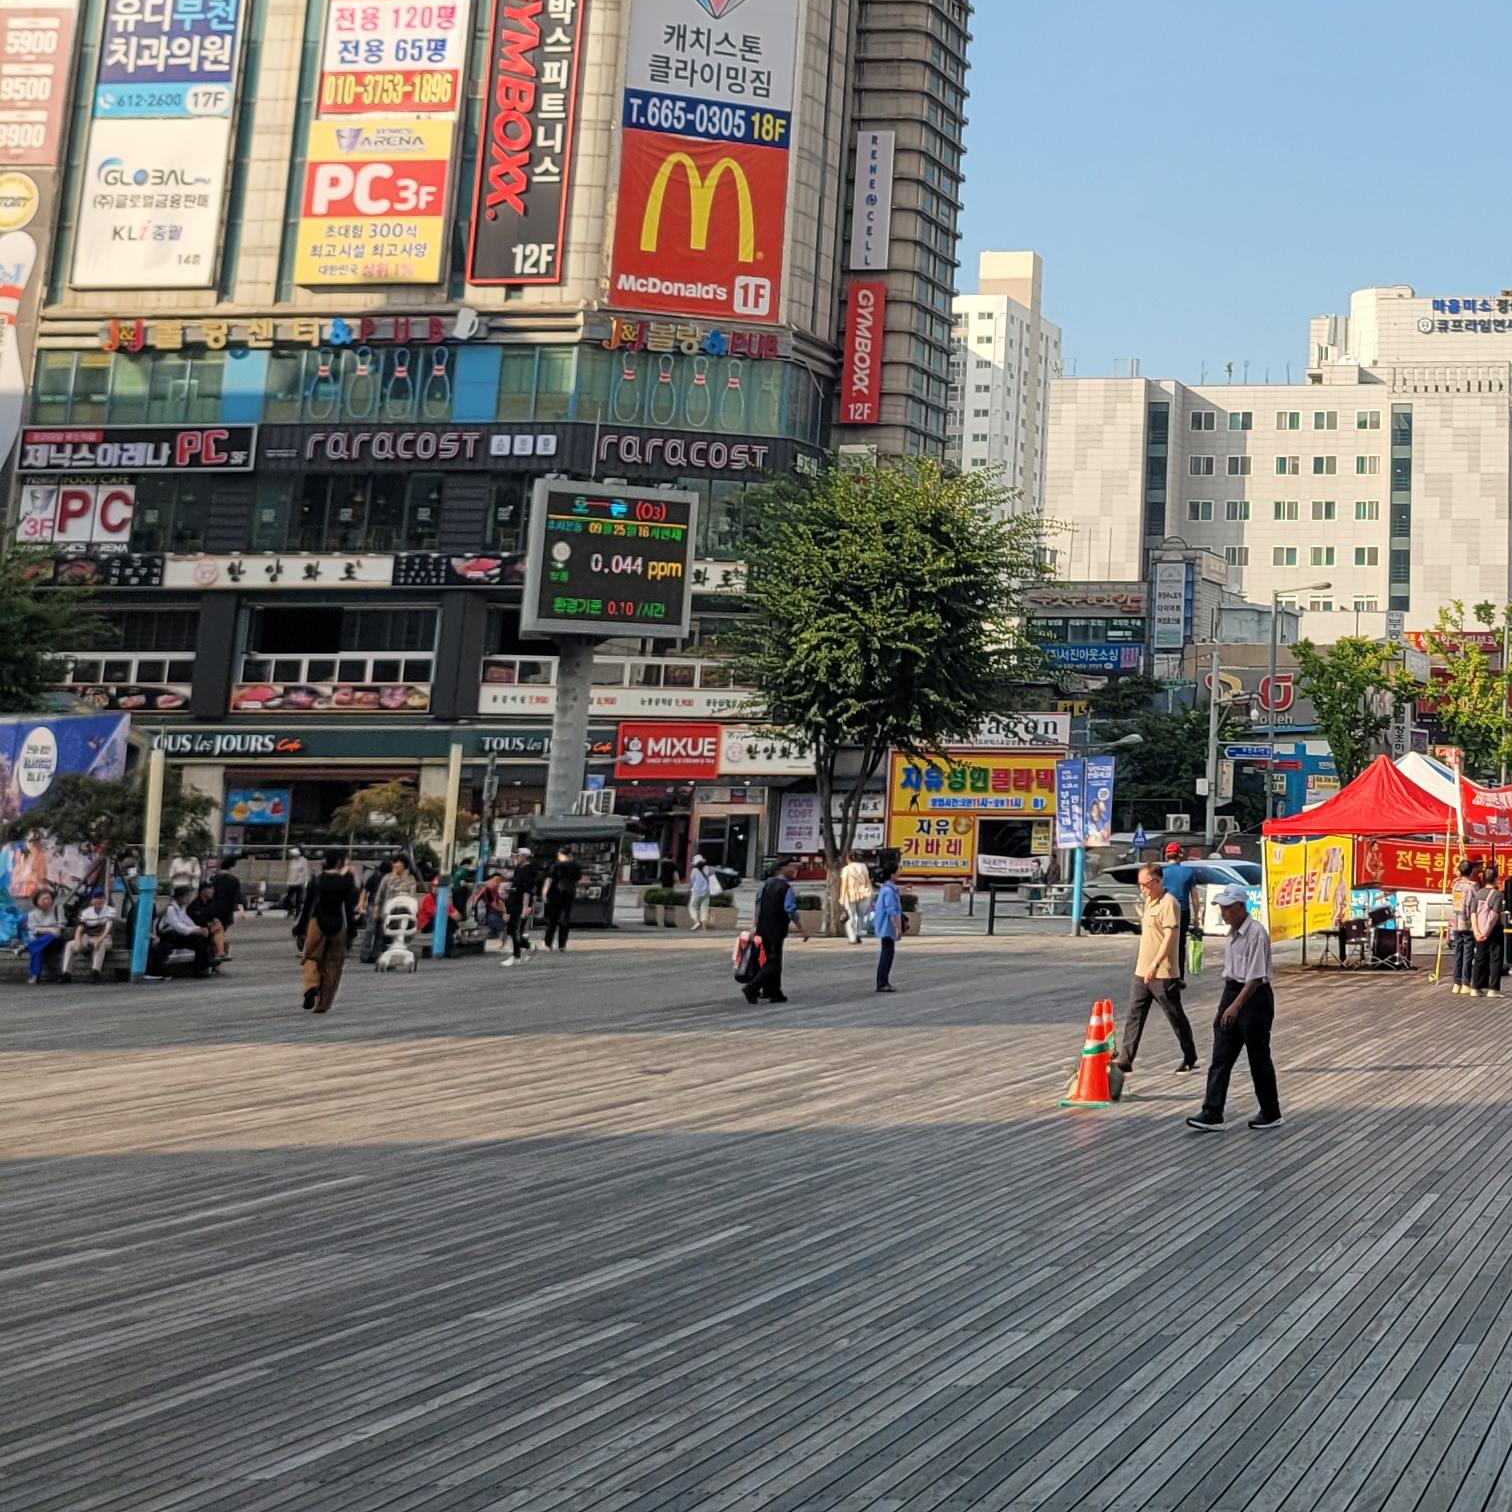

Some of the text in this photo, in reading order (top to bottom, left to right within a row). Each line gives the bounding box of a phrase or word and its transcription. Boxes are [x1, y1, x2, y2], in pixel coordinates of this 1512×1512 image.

[335, 5, 457, 32] 전용 120평
[105, 34, 233, 74] 치과의원
[338, 37, 447, 64] 전용 65평
[662, 23, 763, 63] 캐치스톤
[324, 73, 452, 105] 010-3753-1896
[648, 53, 773, 99] 클라이밍짐
[117, 91, 225, 108] 612-2600 17F
[629, 96, 787, 142] T.665-0305 18F
[310, 162, 437, 216] PC 3F
[511, 243, 556, 275] 12F
[616, 274, 768, 310] McDonald's 1F
[601, 316, 647, 352] J&J
[648, 320, 700, 356] 볼링
[729, 330, 778, 359] PUB
[854, 287, 876, 397] GYMBOXX
[847, 403, 872, 421] 12F
[22, 440, 172, 468] 제닉스아레나
[175, 429, 230, 466] PC
[24, 488, 135, 538] 3F PC
[590, 553, 683, 581] 0.044 ppm
[607, 600, 634, 617] 0.10
[1259, 712, 1293, 725] oleh
[152, 733, 193, 752] OUS
[214, 733, 276, 756] JOURS
[484, 735, 526, 752] TOUS
[646, 736, 717, 757] MIXUE
[900, 766, 1056, 794] 자유성인콜라텍
[915, 818, 950, 836] 자유
[903, 837, 963, 857] 카바레
